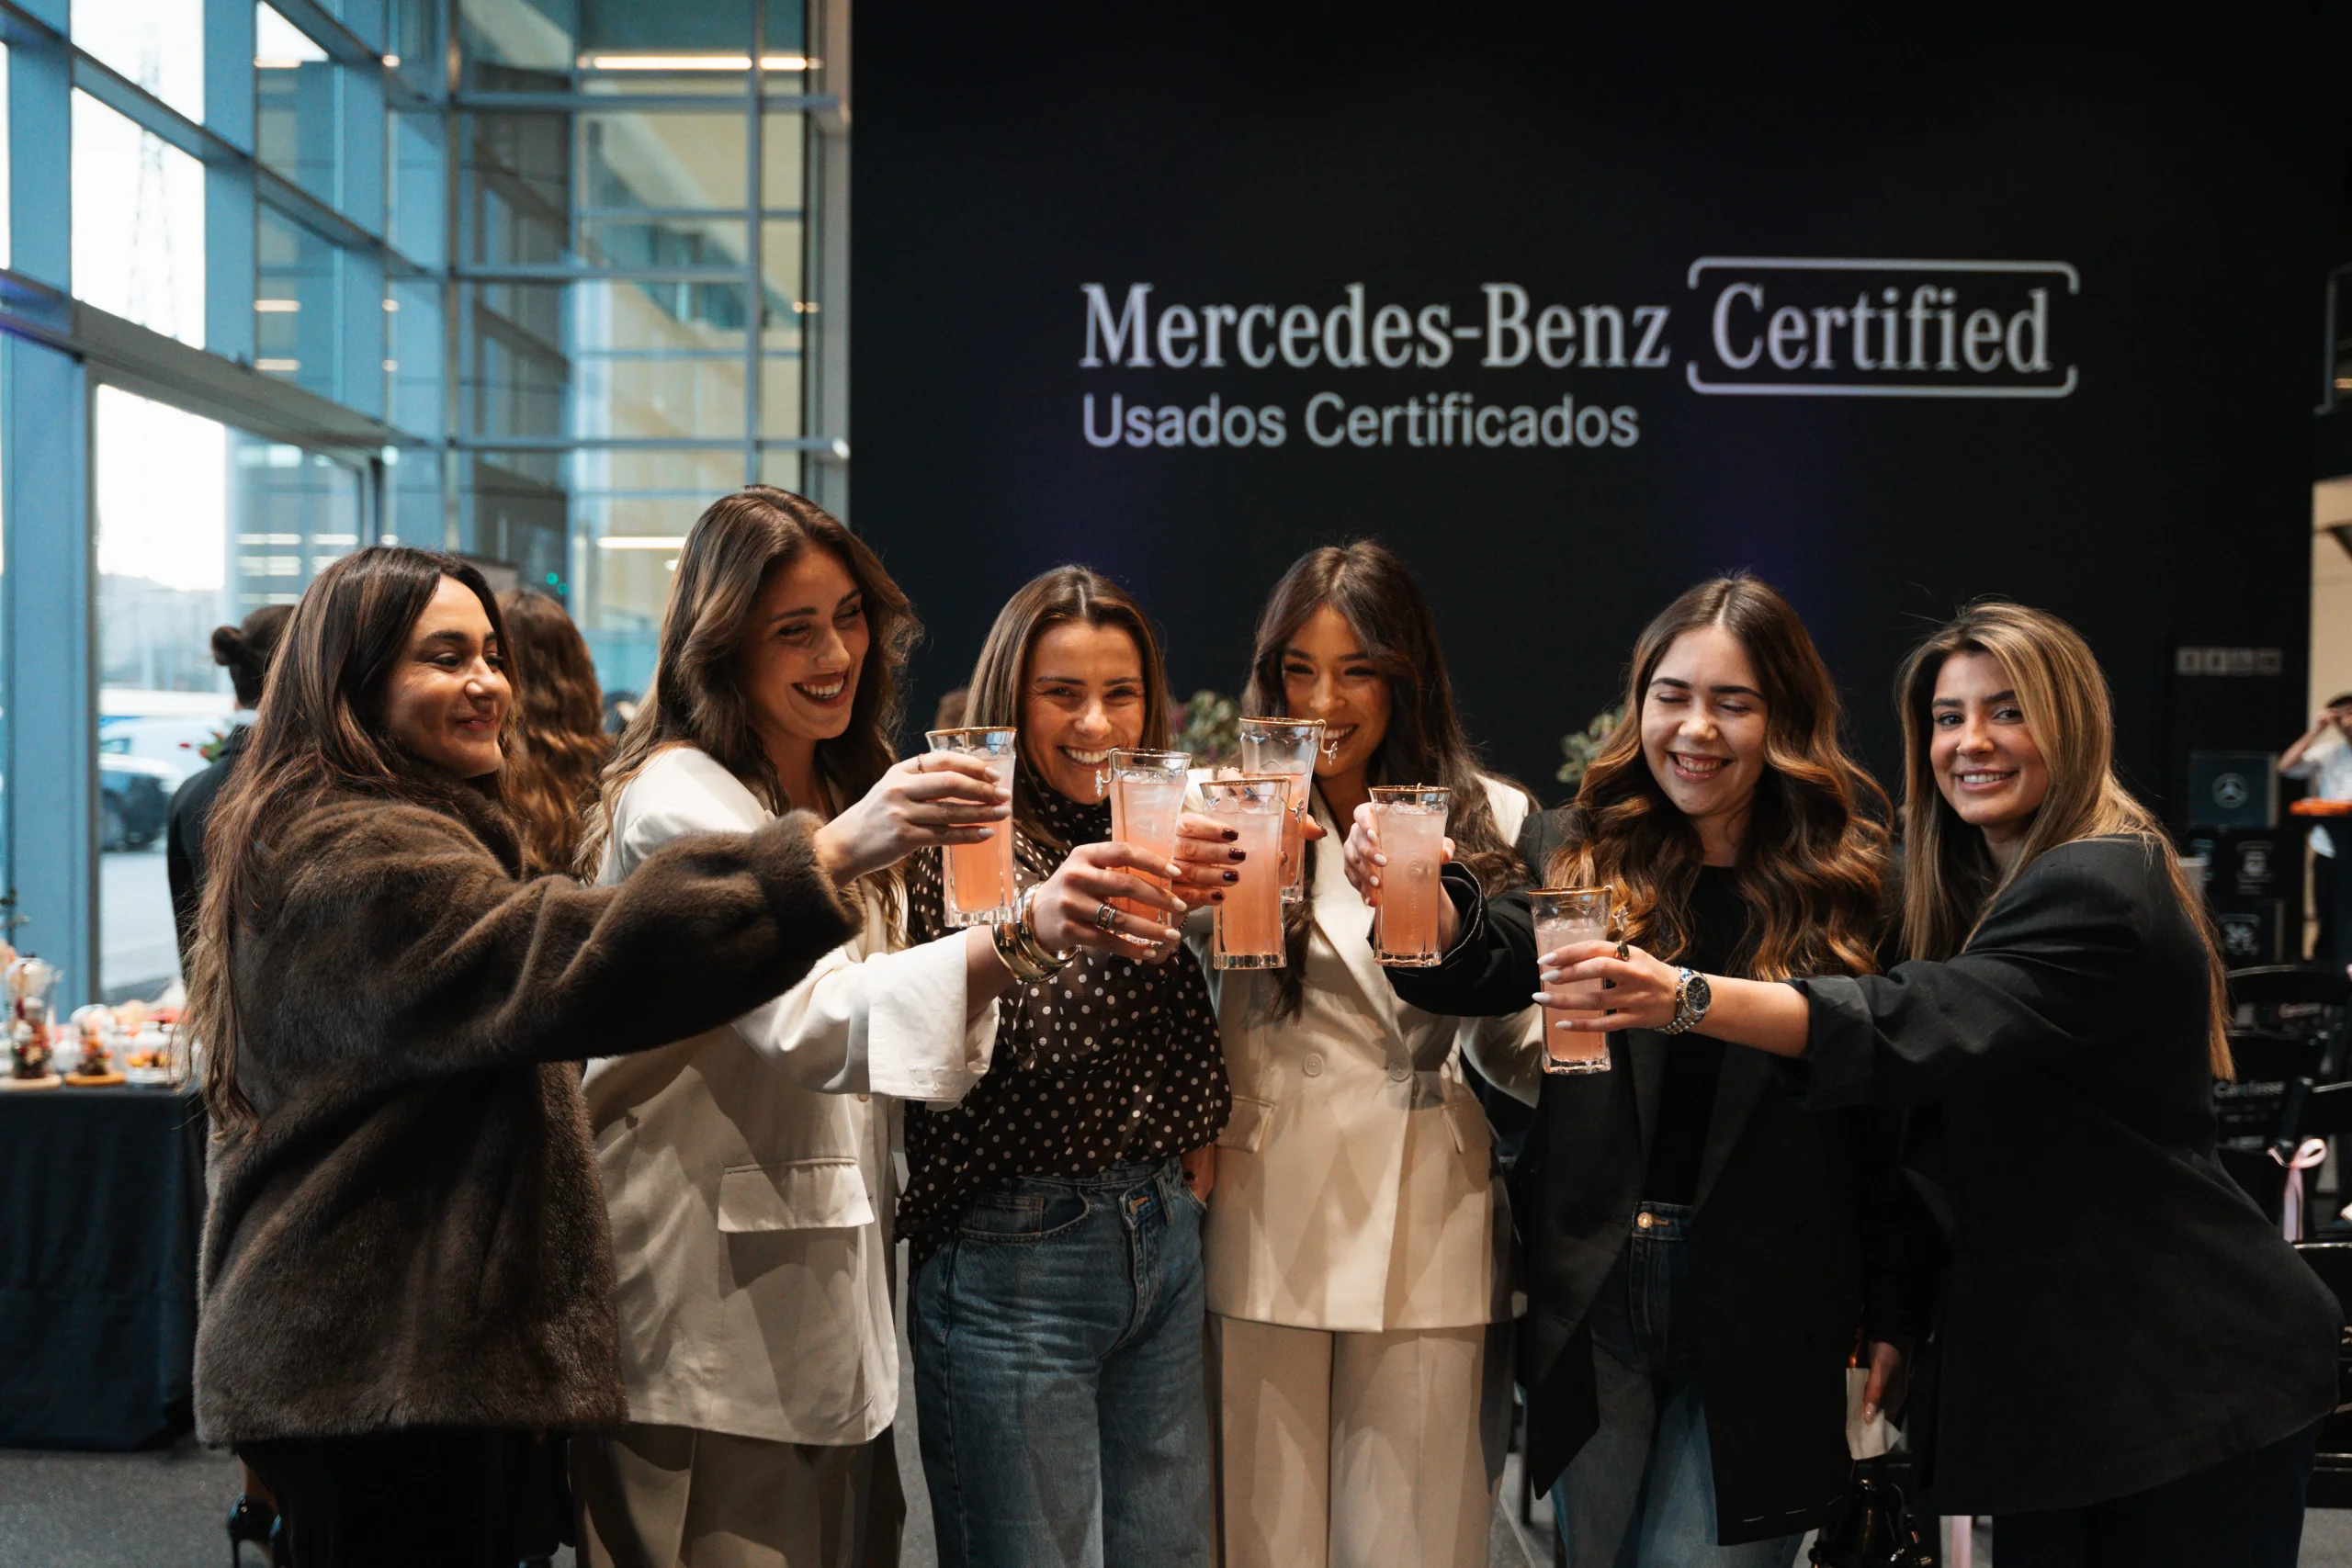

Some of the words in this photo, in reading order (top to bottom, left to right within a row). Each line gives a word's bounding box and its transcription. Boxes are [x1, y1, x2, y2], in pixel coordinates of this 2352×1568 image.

[1080, 282, 1671, 367] Mercedes-Benz
[1713, 282, 2052, 371] Certified
[1083, 392, 1287, 447] Usados
[1305, 391, 1641, 447] Certificados
